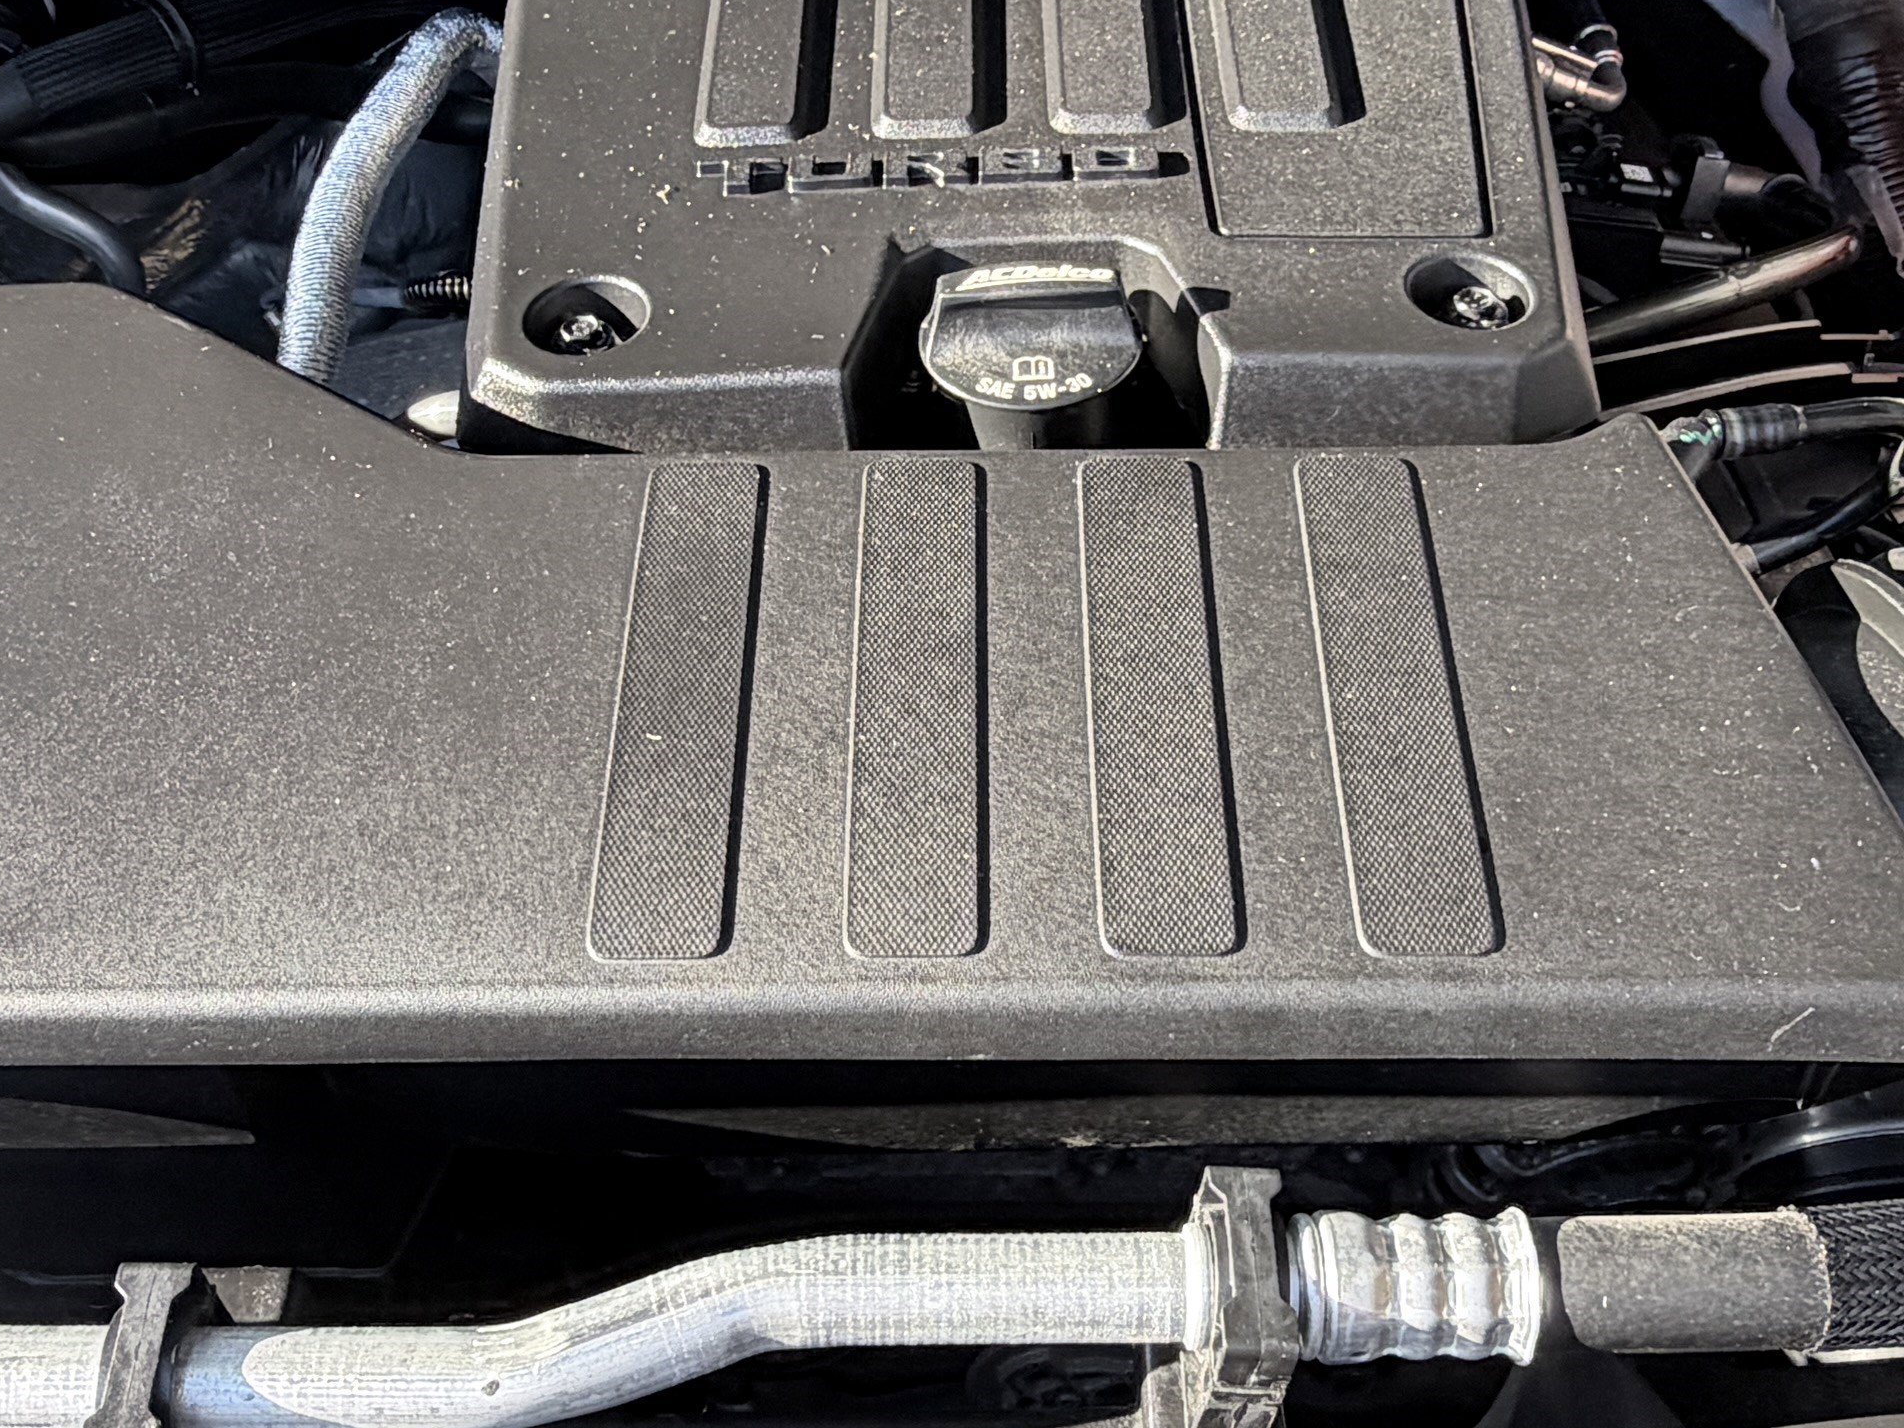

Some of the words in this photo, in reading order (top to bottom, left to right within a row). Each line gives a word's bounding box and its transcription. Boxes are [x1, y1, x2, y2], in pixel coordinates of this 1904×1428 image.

[696, 144, 1161, 197] TURBO
[956, 264, 1116, 291] ACDelco
[975, 377, 1016, 401] SAE
[1023, 373, 1093, 401] 5W-30
